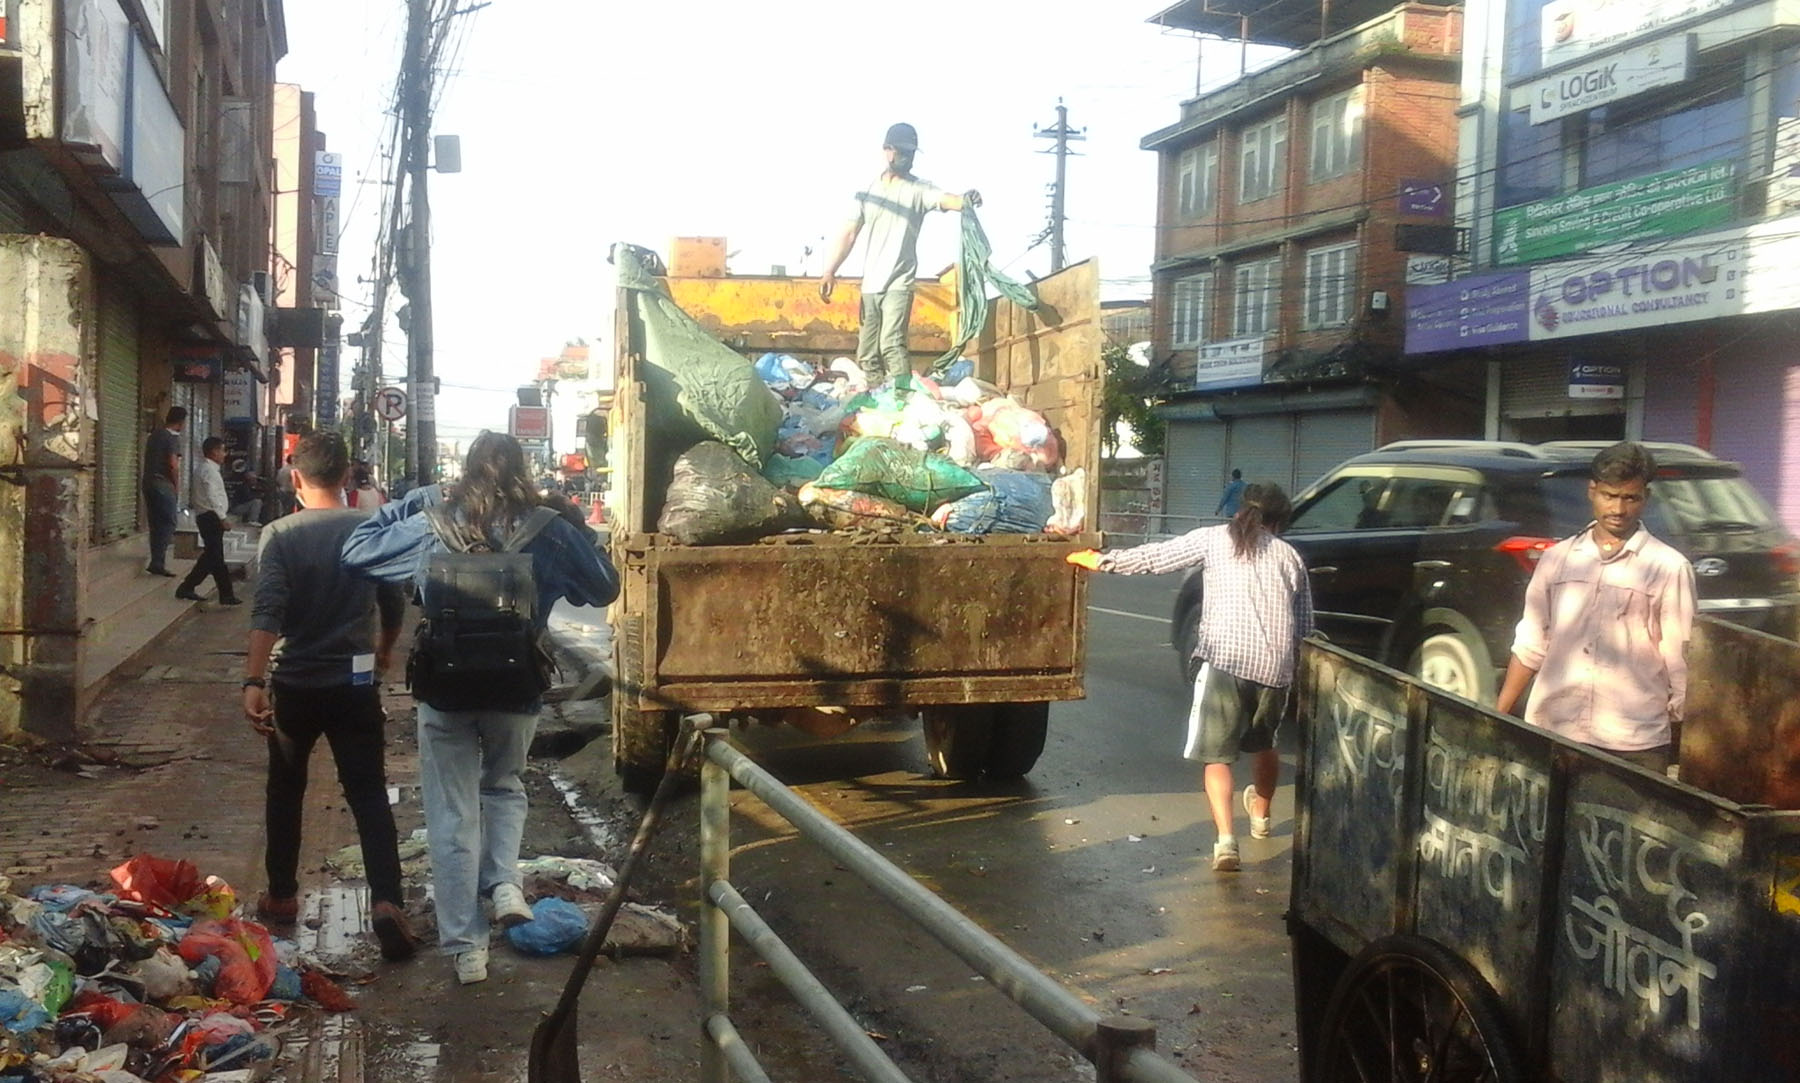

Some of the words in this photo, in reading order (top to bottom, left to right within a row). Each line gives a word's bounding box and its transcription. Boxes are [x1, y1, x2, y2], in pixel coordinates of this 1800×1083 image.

[317, 165, 342, 176] OPAL
[1561, 254, 1712, 305] OPTION
[1631, 292, 1709, 314] CONSULTANCY
[1565, 894, 1718, 1031] जीवन
